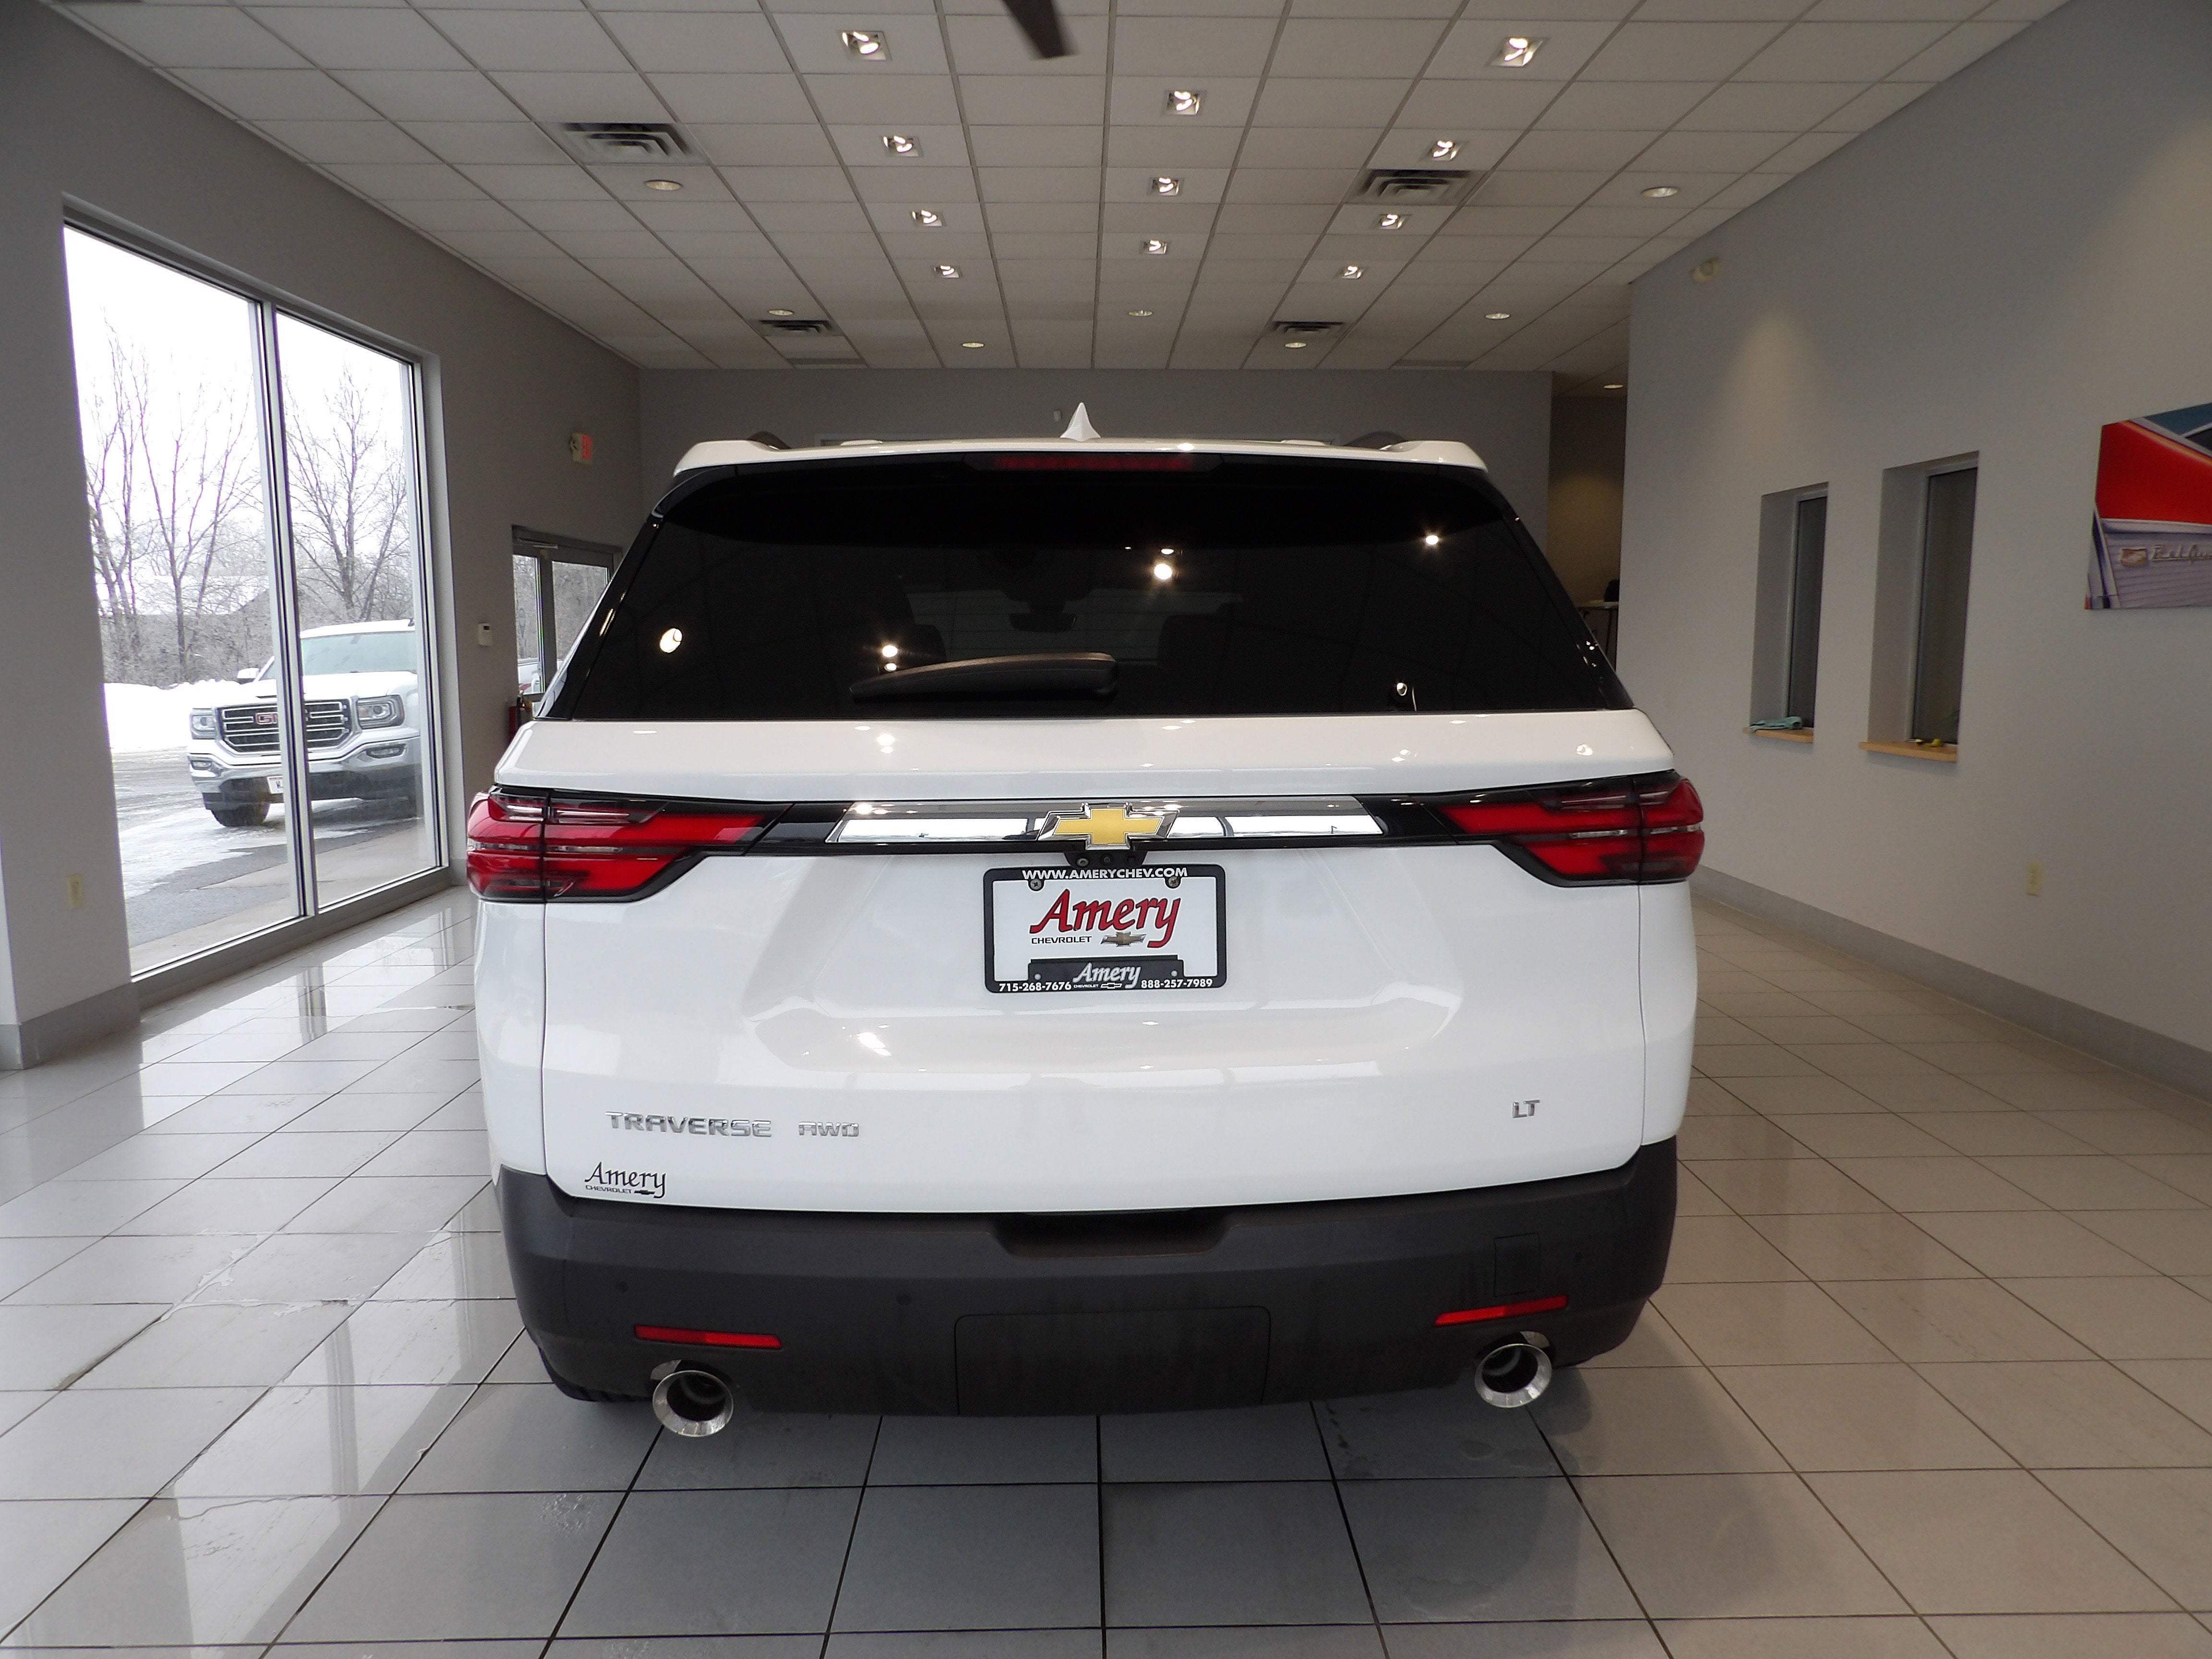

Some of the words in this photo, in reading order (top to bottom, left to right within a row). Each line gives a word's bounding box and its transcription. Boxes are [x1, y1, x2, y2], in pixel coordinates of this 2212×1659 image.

[1022, 868, 1188, 879] WWW.AMERYCHEV.COM
[1029, 889, 1181, 948] Amery
[1031, 936, 1092, 944] CHEVROLET
[1072, 962, 1141, 989] Amery
[999, 981, 1071, 991] 715-268-7676
[1141, 978, 1213, 989] 888-257-7989
[1512, 1099, 1540, 1118] LT
[605, 1111, 772, 1137] TRAVERSE
[798, 1121, 860, 1137] AWD
[584, 1161, 666, 1198] Amery
[585, 1184, 633, 1194] CHEVROLET
